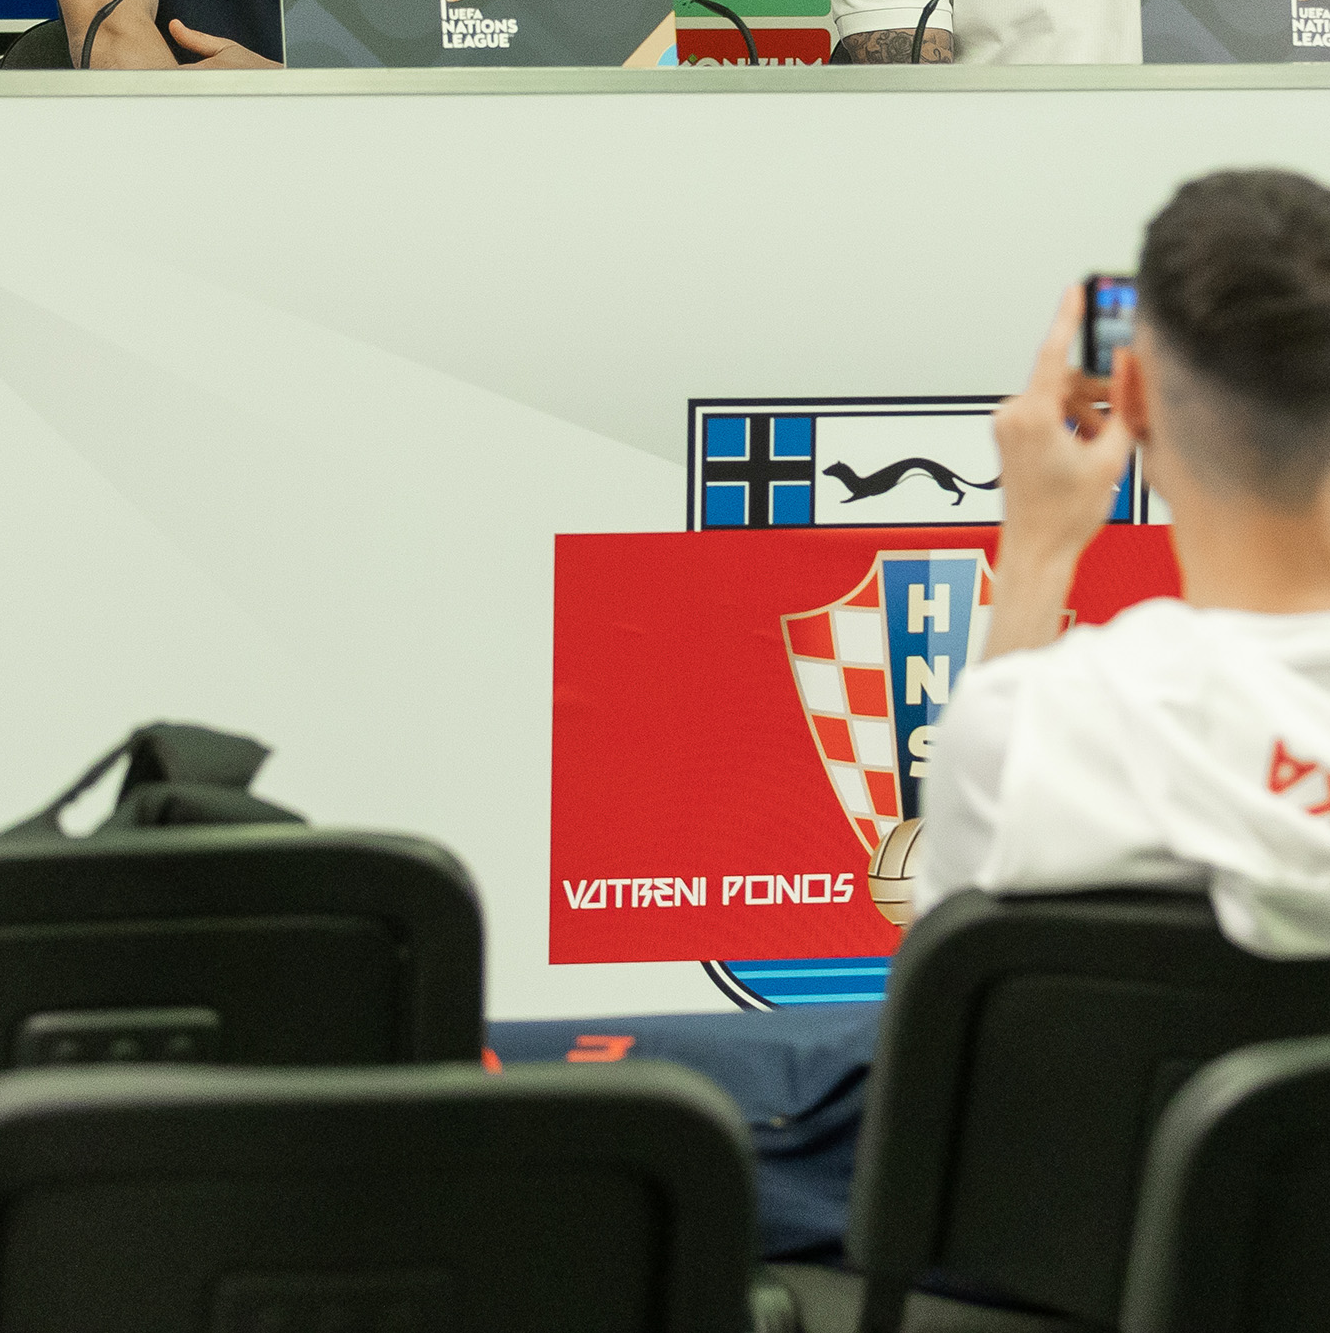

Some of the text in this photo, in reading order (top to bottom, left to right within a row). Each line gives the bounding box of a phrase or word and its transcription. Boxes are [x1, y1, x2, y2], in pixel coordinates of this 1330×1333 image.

[449, 8, 482, 21] UEFA
[1299, 7, 1330, 20] UEFA
[443, 19, 518, 34] NATIONS
[443, 33, 509, 49] LEAGUE
[563, 873, 854, 909] VATRENI PONOS
